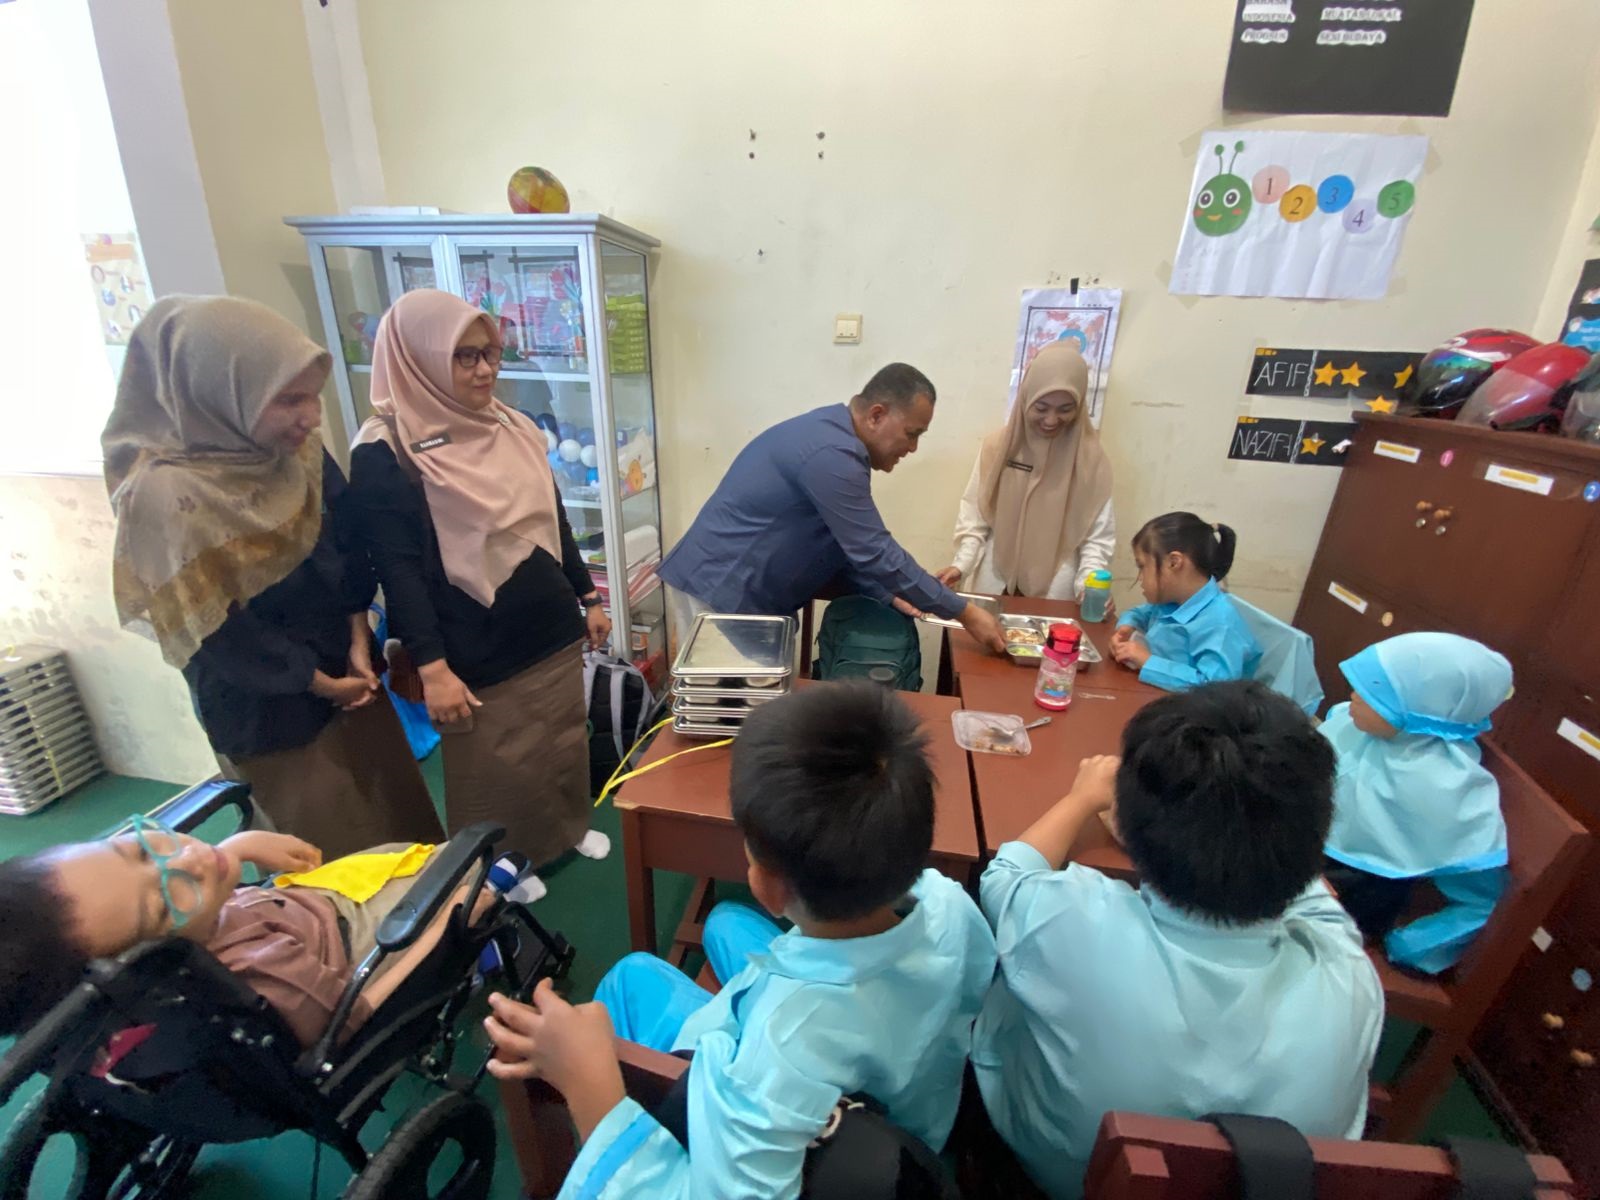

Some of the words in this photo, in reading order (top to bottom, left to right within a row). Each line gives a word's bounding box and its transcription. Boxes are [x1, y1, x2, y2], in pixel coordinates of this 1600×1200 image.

[1266, 178, 1273, 196] 1
[1289, 197, 1304, 215] 2
[1325, 187, 1340, 206] 3
[1352, 210, 1365, 227] 4
[1389, 192, 1401, 211] 5
[1253, 361, 1310, 387] AFIF
